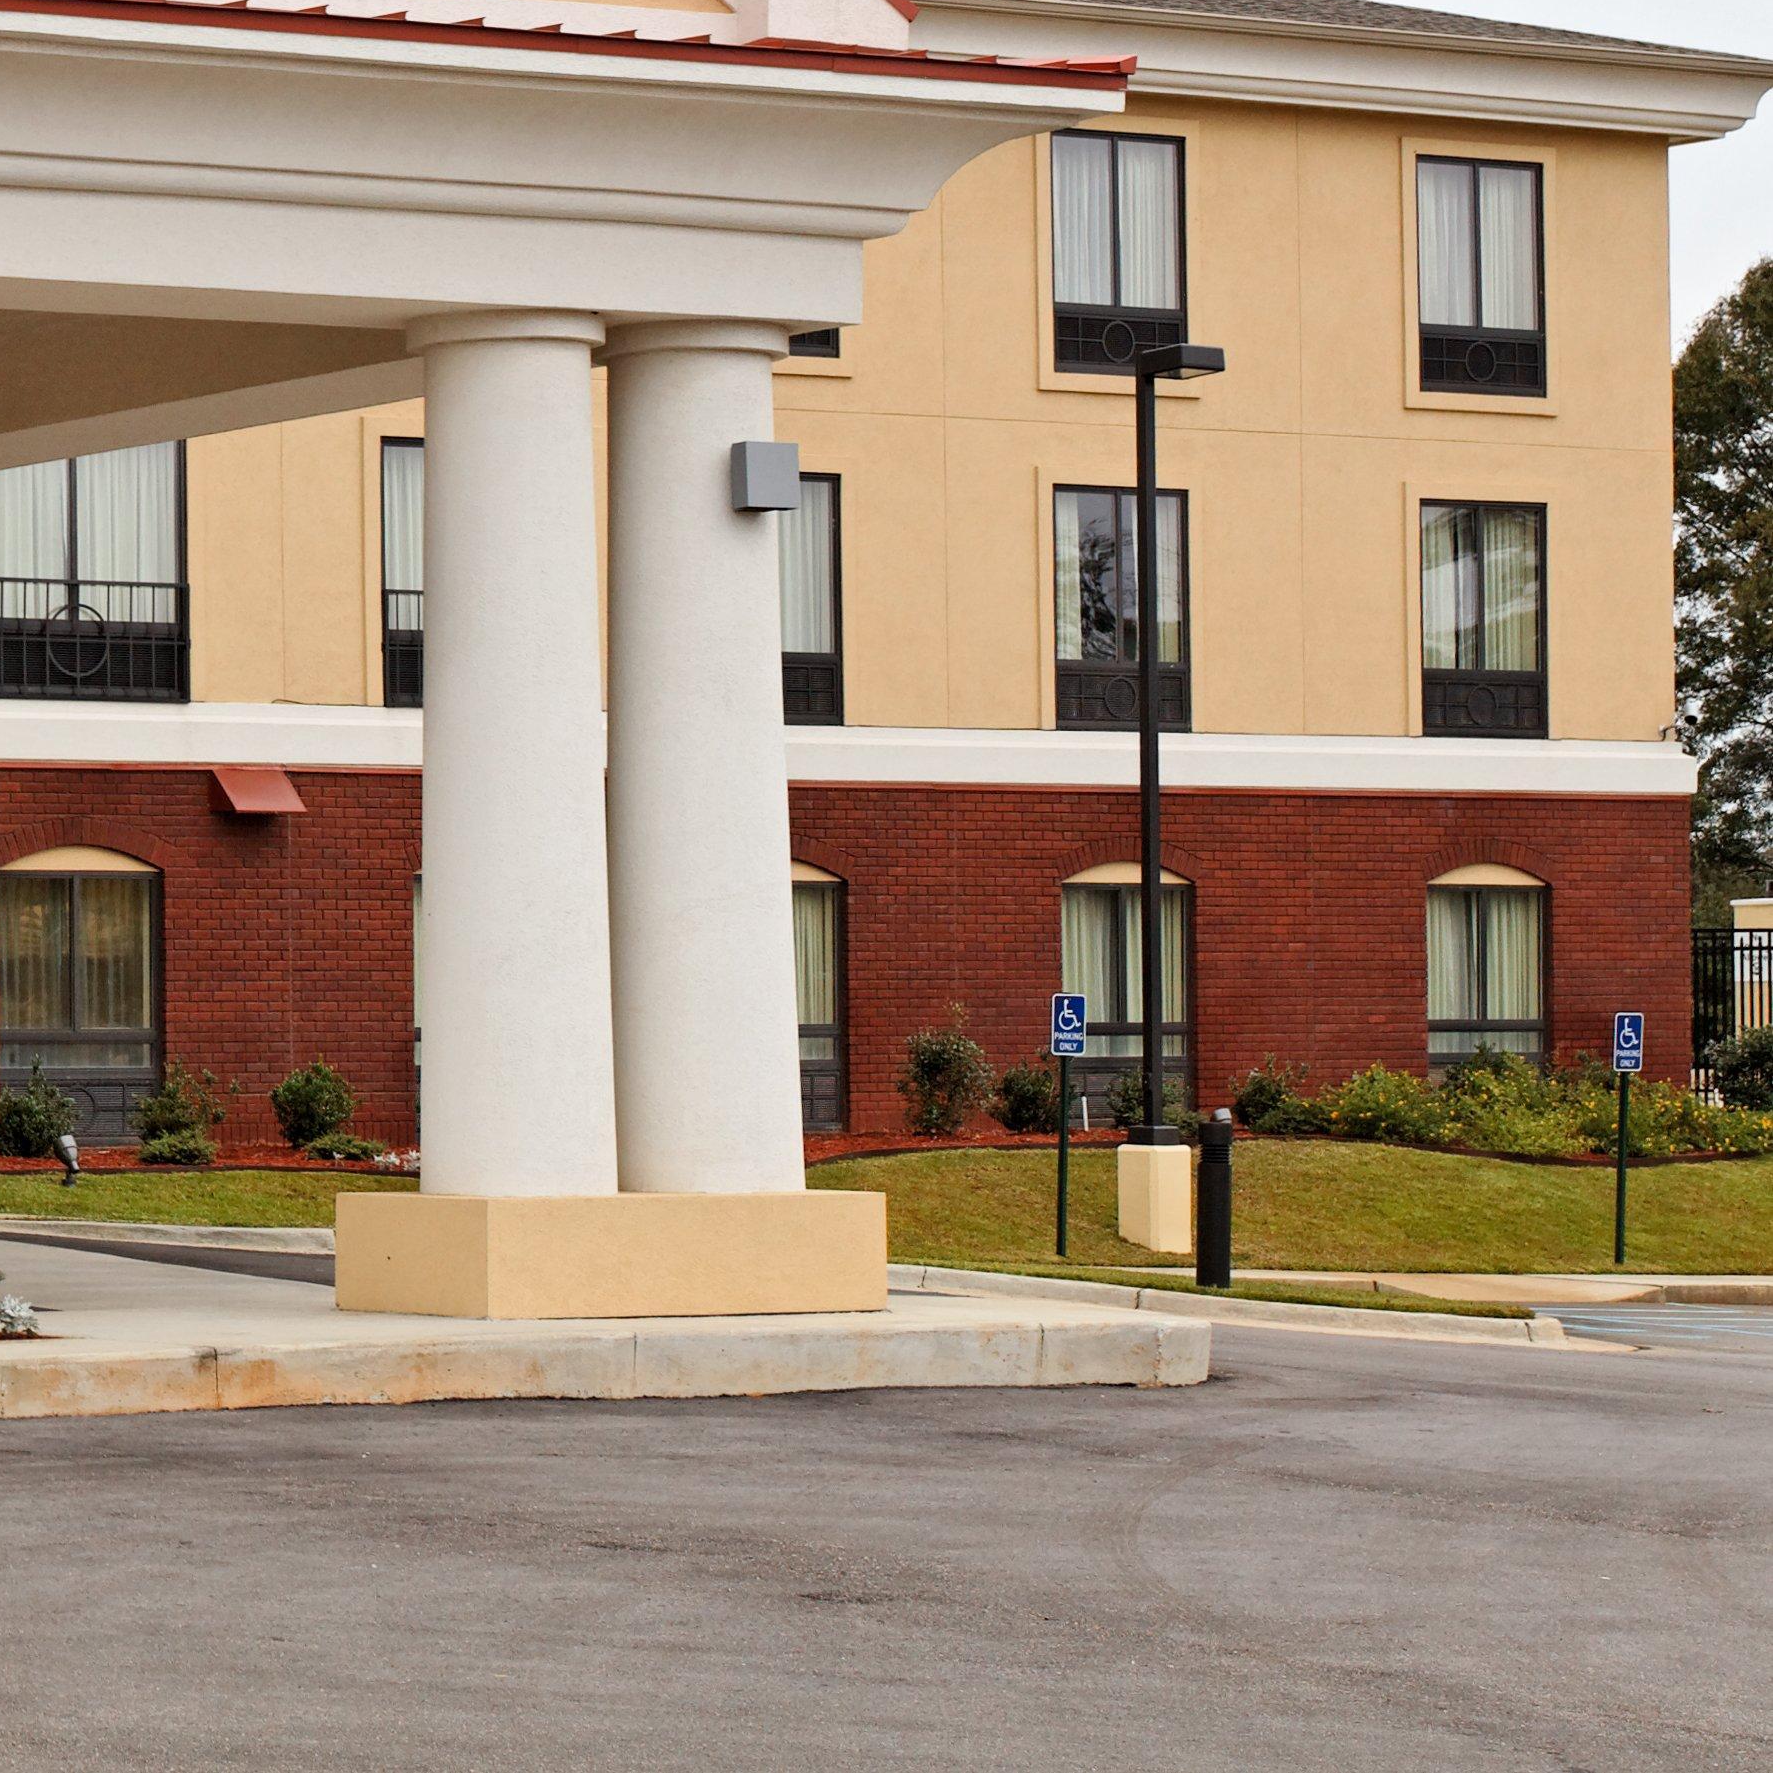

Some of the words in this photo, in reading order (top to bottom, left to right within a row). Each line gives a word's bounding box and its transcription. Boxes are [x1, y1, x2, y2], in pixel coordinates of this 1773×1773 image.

[1054, 1031, 1084, 1041] PARKING
[1059, 1042, 1078, 1051] ONLY
[1619, 1058, 1636, 1068] ONLY
